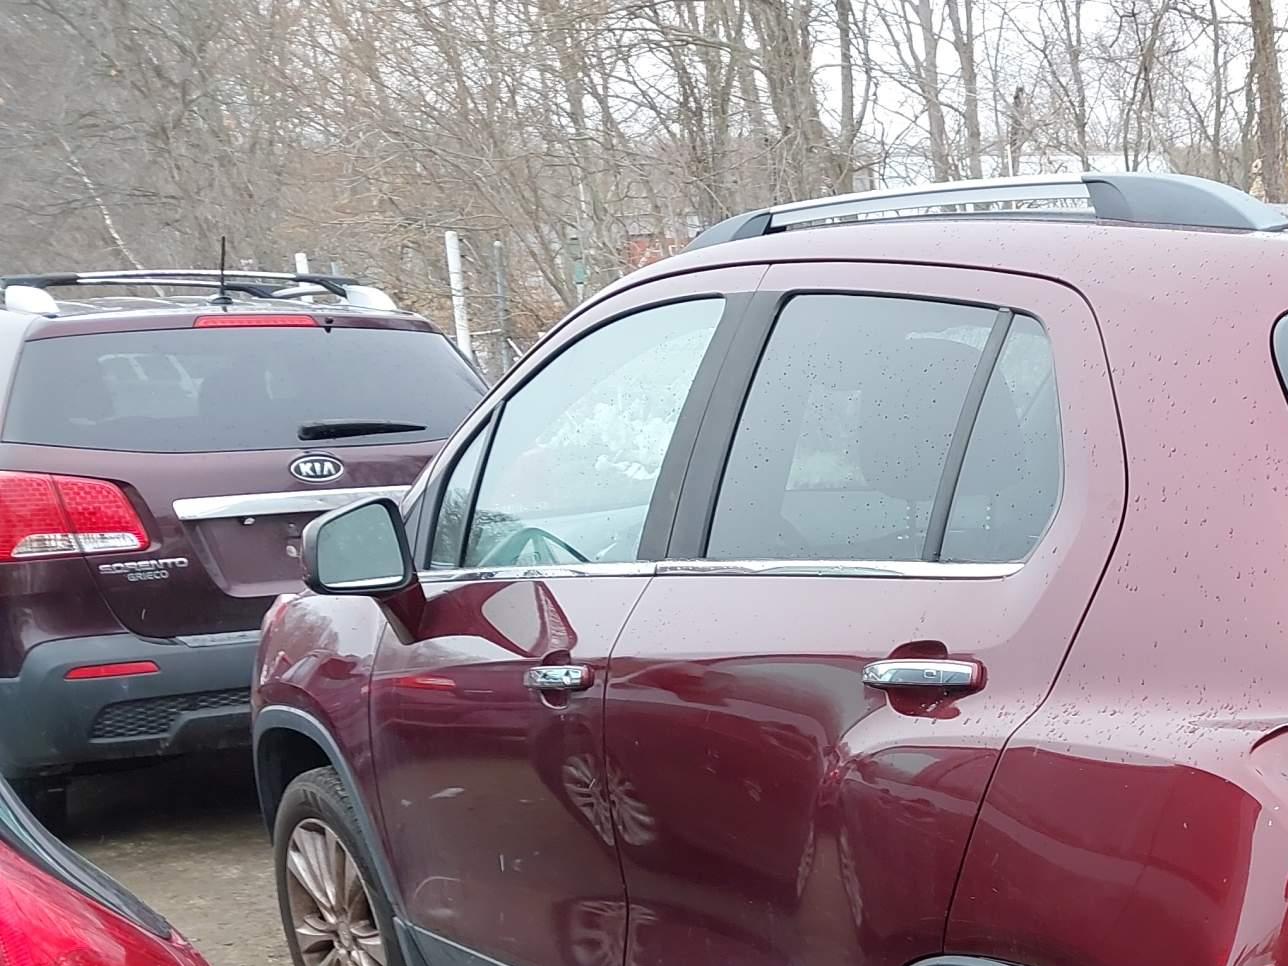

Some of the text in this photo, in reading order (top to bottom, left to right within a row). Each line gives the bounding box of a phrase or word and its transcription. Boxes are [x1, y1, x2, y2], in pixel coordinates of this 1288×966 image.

[298, 461, 336, 476] KIA
[98, 557, 189, 574] SORENTO
[127, 569, 169, 582] GRIECO
